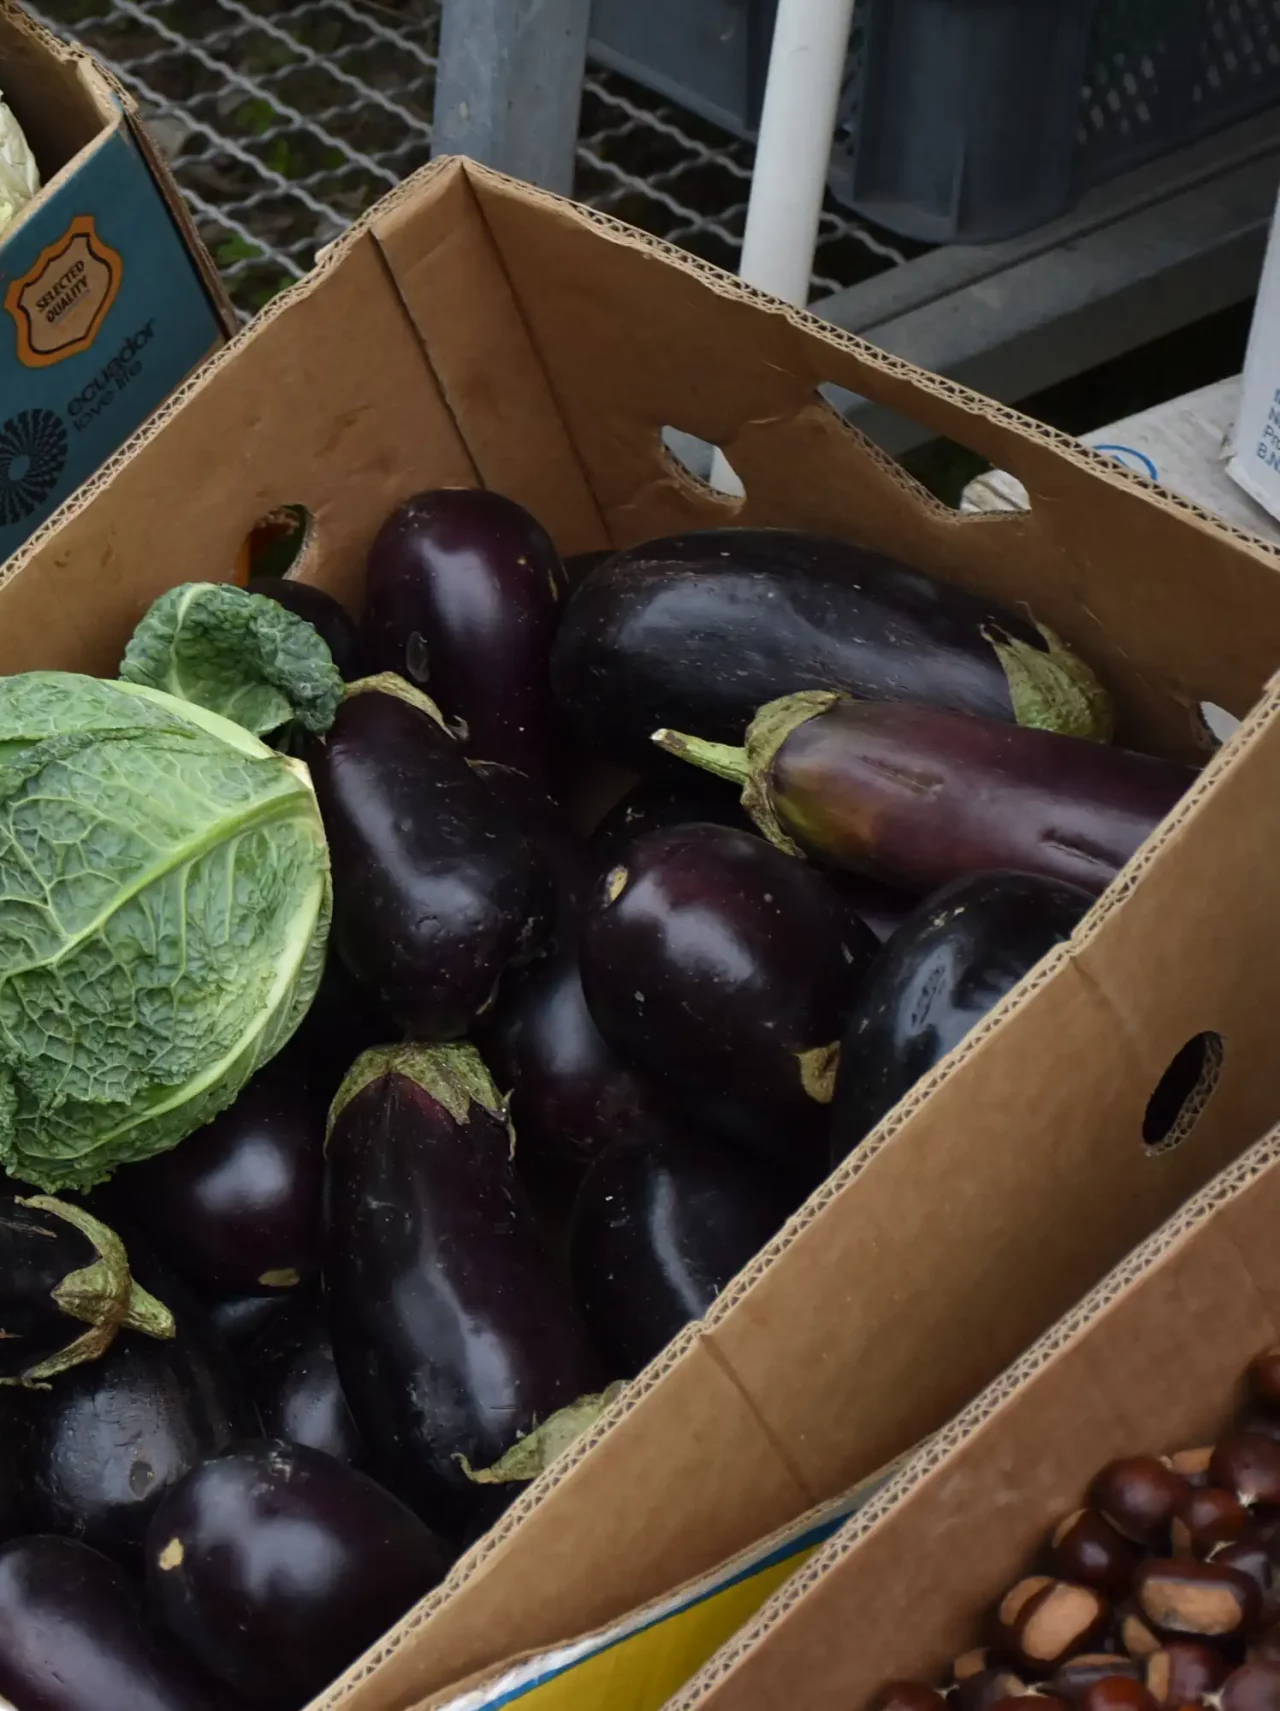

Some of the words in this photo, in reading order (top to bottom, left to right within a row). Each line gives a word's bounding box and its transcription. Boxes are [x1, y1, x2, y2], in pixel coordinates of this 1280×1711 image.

[36, 259, 86, 313] SELECTED
[45, 273, 90, 324] QUALITY
[67, 319, 156, 417] ecuador
[72, 388, 116, 433] love
[113, 360, 144, 391] life
